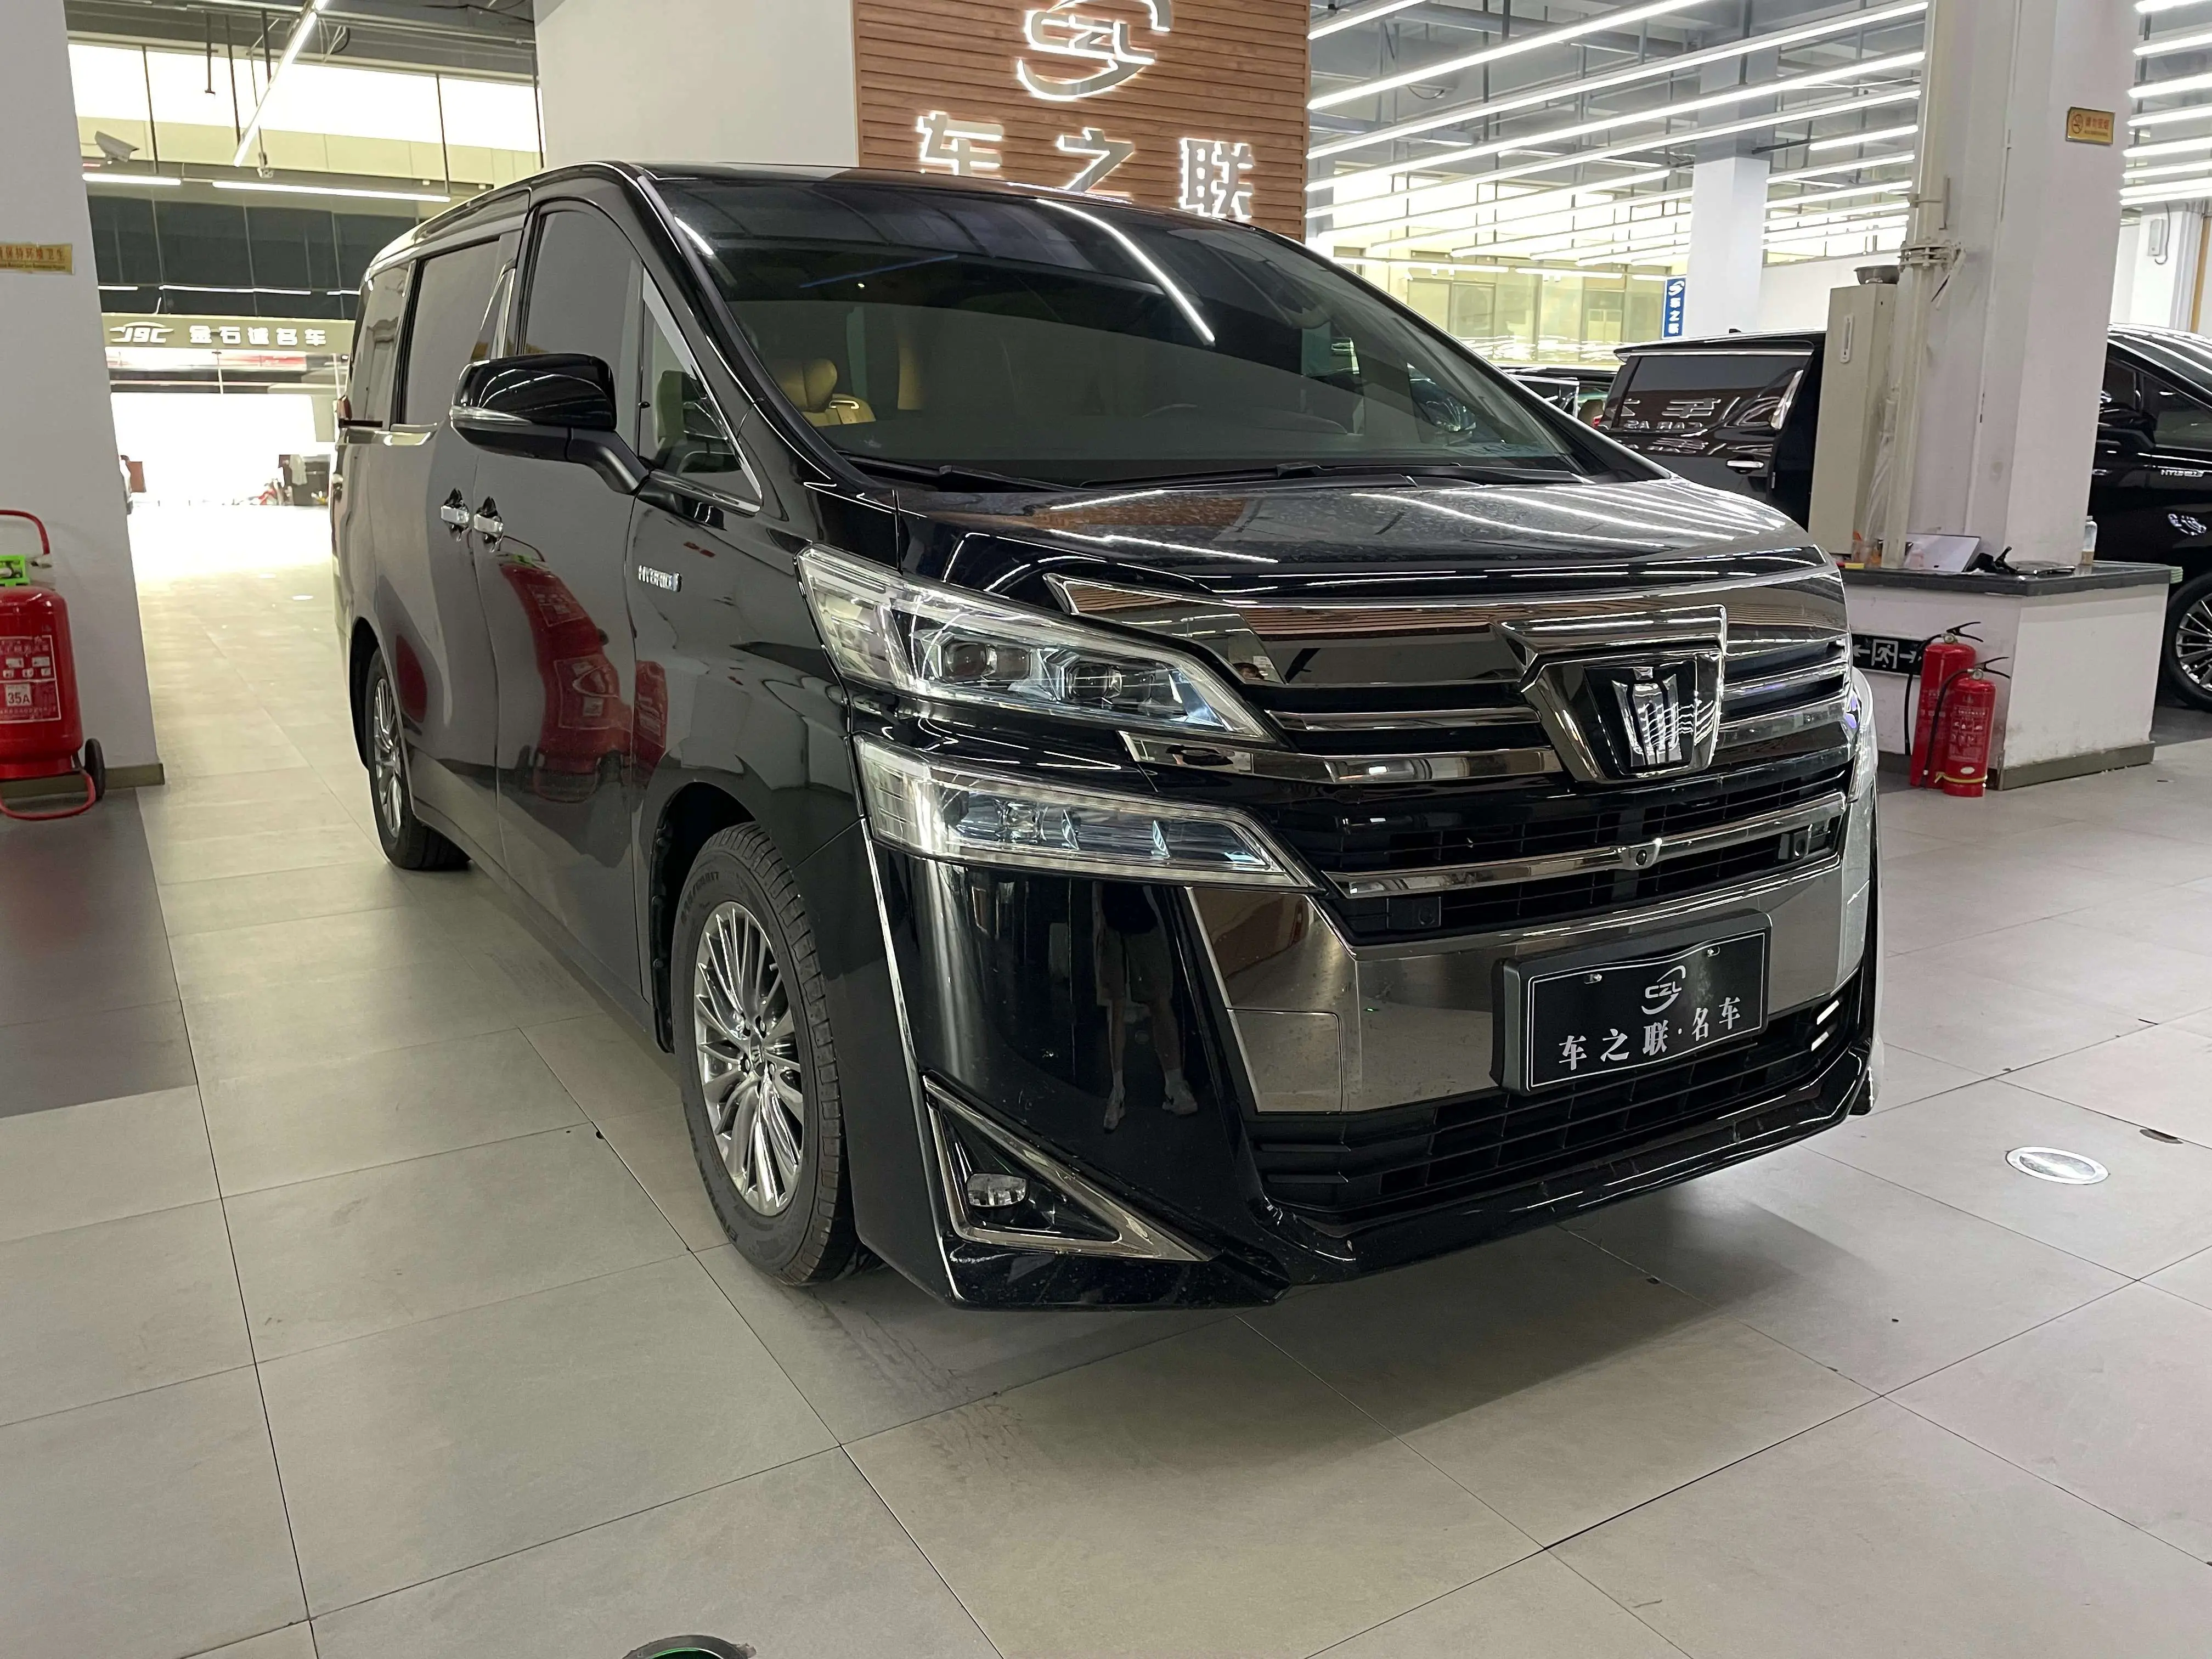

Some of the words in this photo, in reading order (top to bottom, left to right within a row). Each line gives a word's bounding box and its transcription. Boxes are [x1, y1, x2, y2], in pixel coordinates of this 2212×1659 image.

[915, 110, 1256, 219] 车之联
[638, 565, 679, 591] HYBRID
[8, 692, 31, 704] 35A
